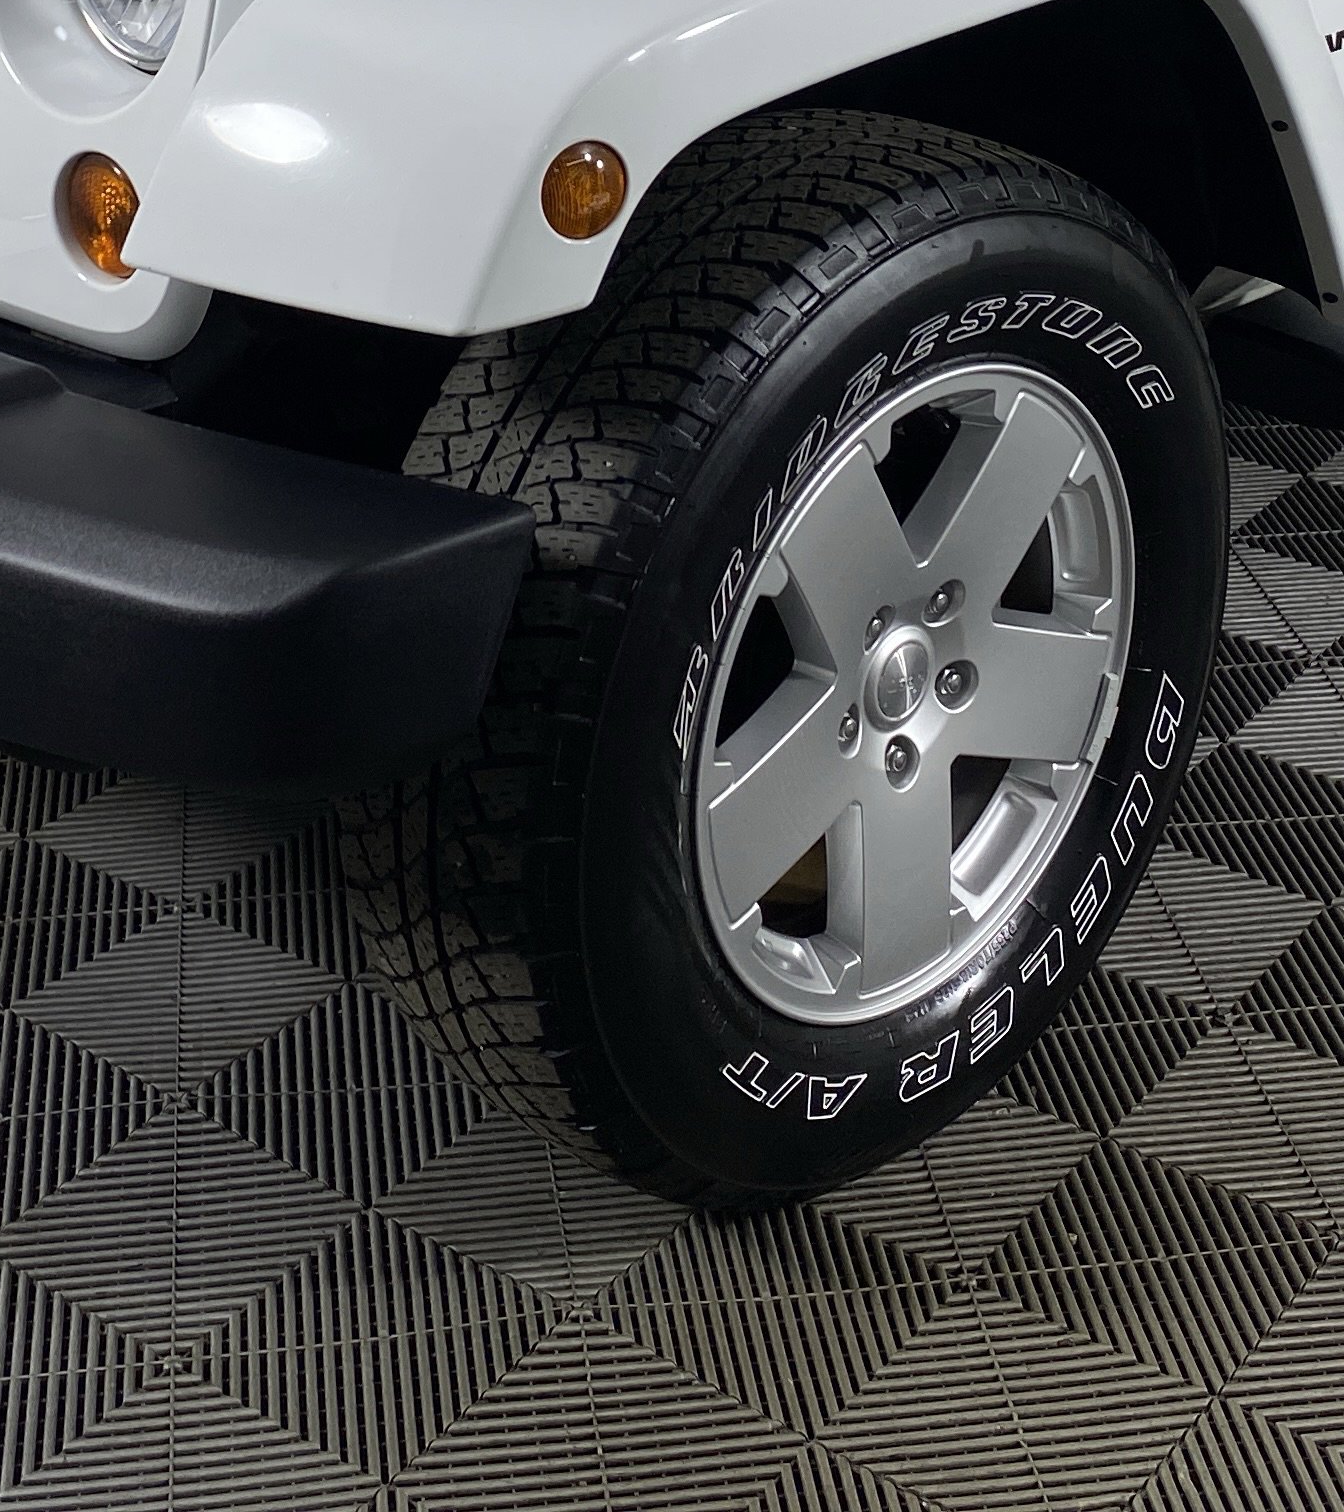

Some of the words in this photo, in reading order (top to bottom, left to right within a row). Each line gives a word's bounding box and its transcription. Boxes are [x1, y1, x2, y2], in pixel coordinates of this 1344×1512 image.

[674, 291, 1174, 763] BRIDGESTONE
[722, 1052, 867, 1120] A/T
[900, 673, 1184, 1102] DUELER
